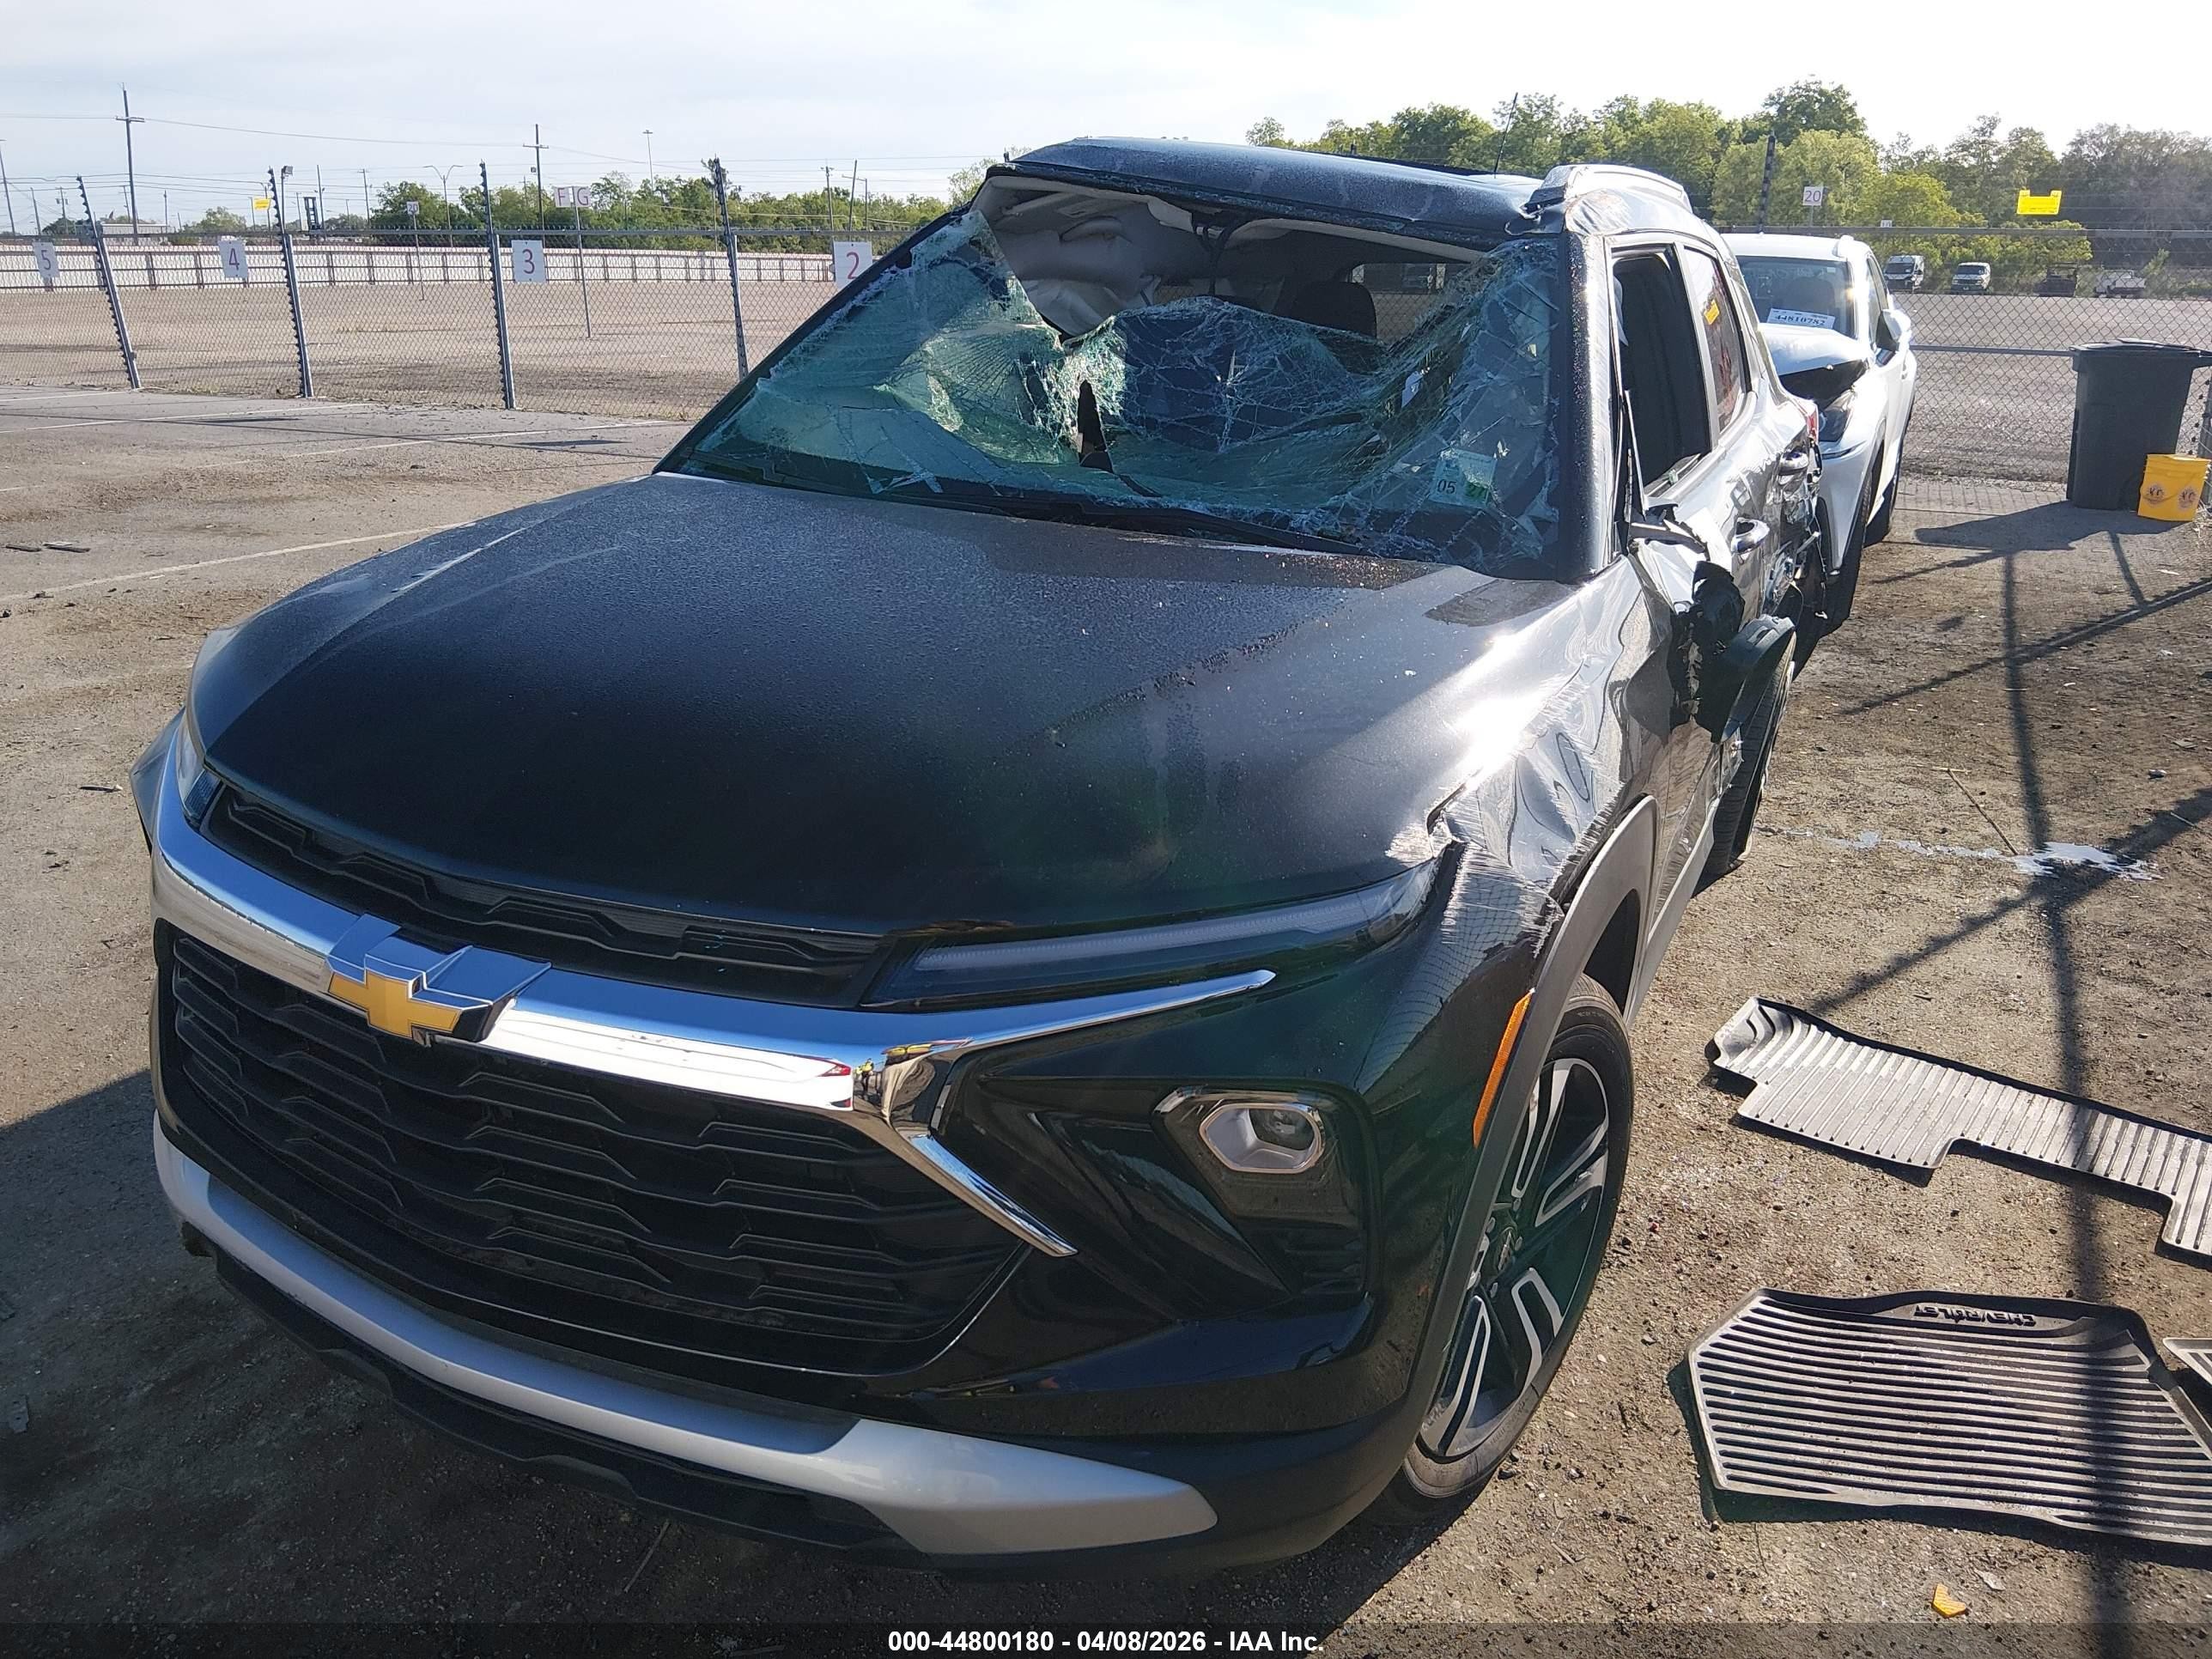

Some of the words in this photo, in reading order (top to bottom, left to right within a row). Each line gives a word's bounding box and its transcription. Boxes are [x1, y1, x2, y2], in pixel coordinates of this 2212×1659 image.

[557, 187, 566, 207] F
[576, 187, 589, 206] G
[1804, 190, 1821, 203] 20
[40, 249, 52, 270] 5
[228, 247, 240, 270] 4
[522, 248, 536, 274] 3
[846, 252, 860, 280] 2
[1774, 313, 1826, 325] 44810782
[1437, 479, 1456, 495] 05
